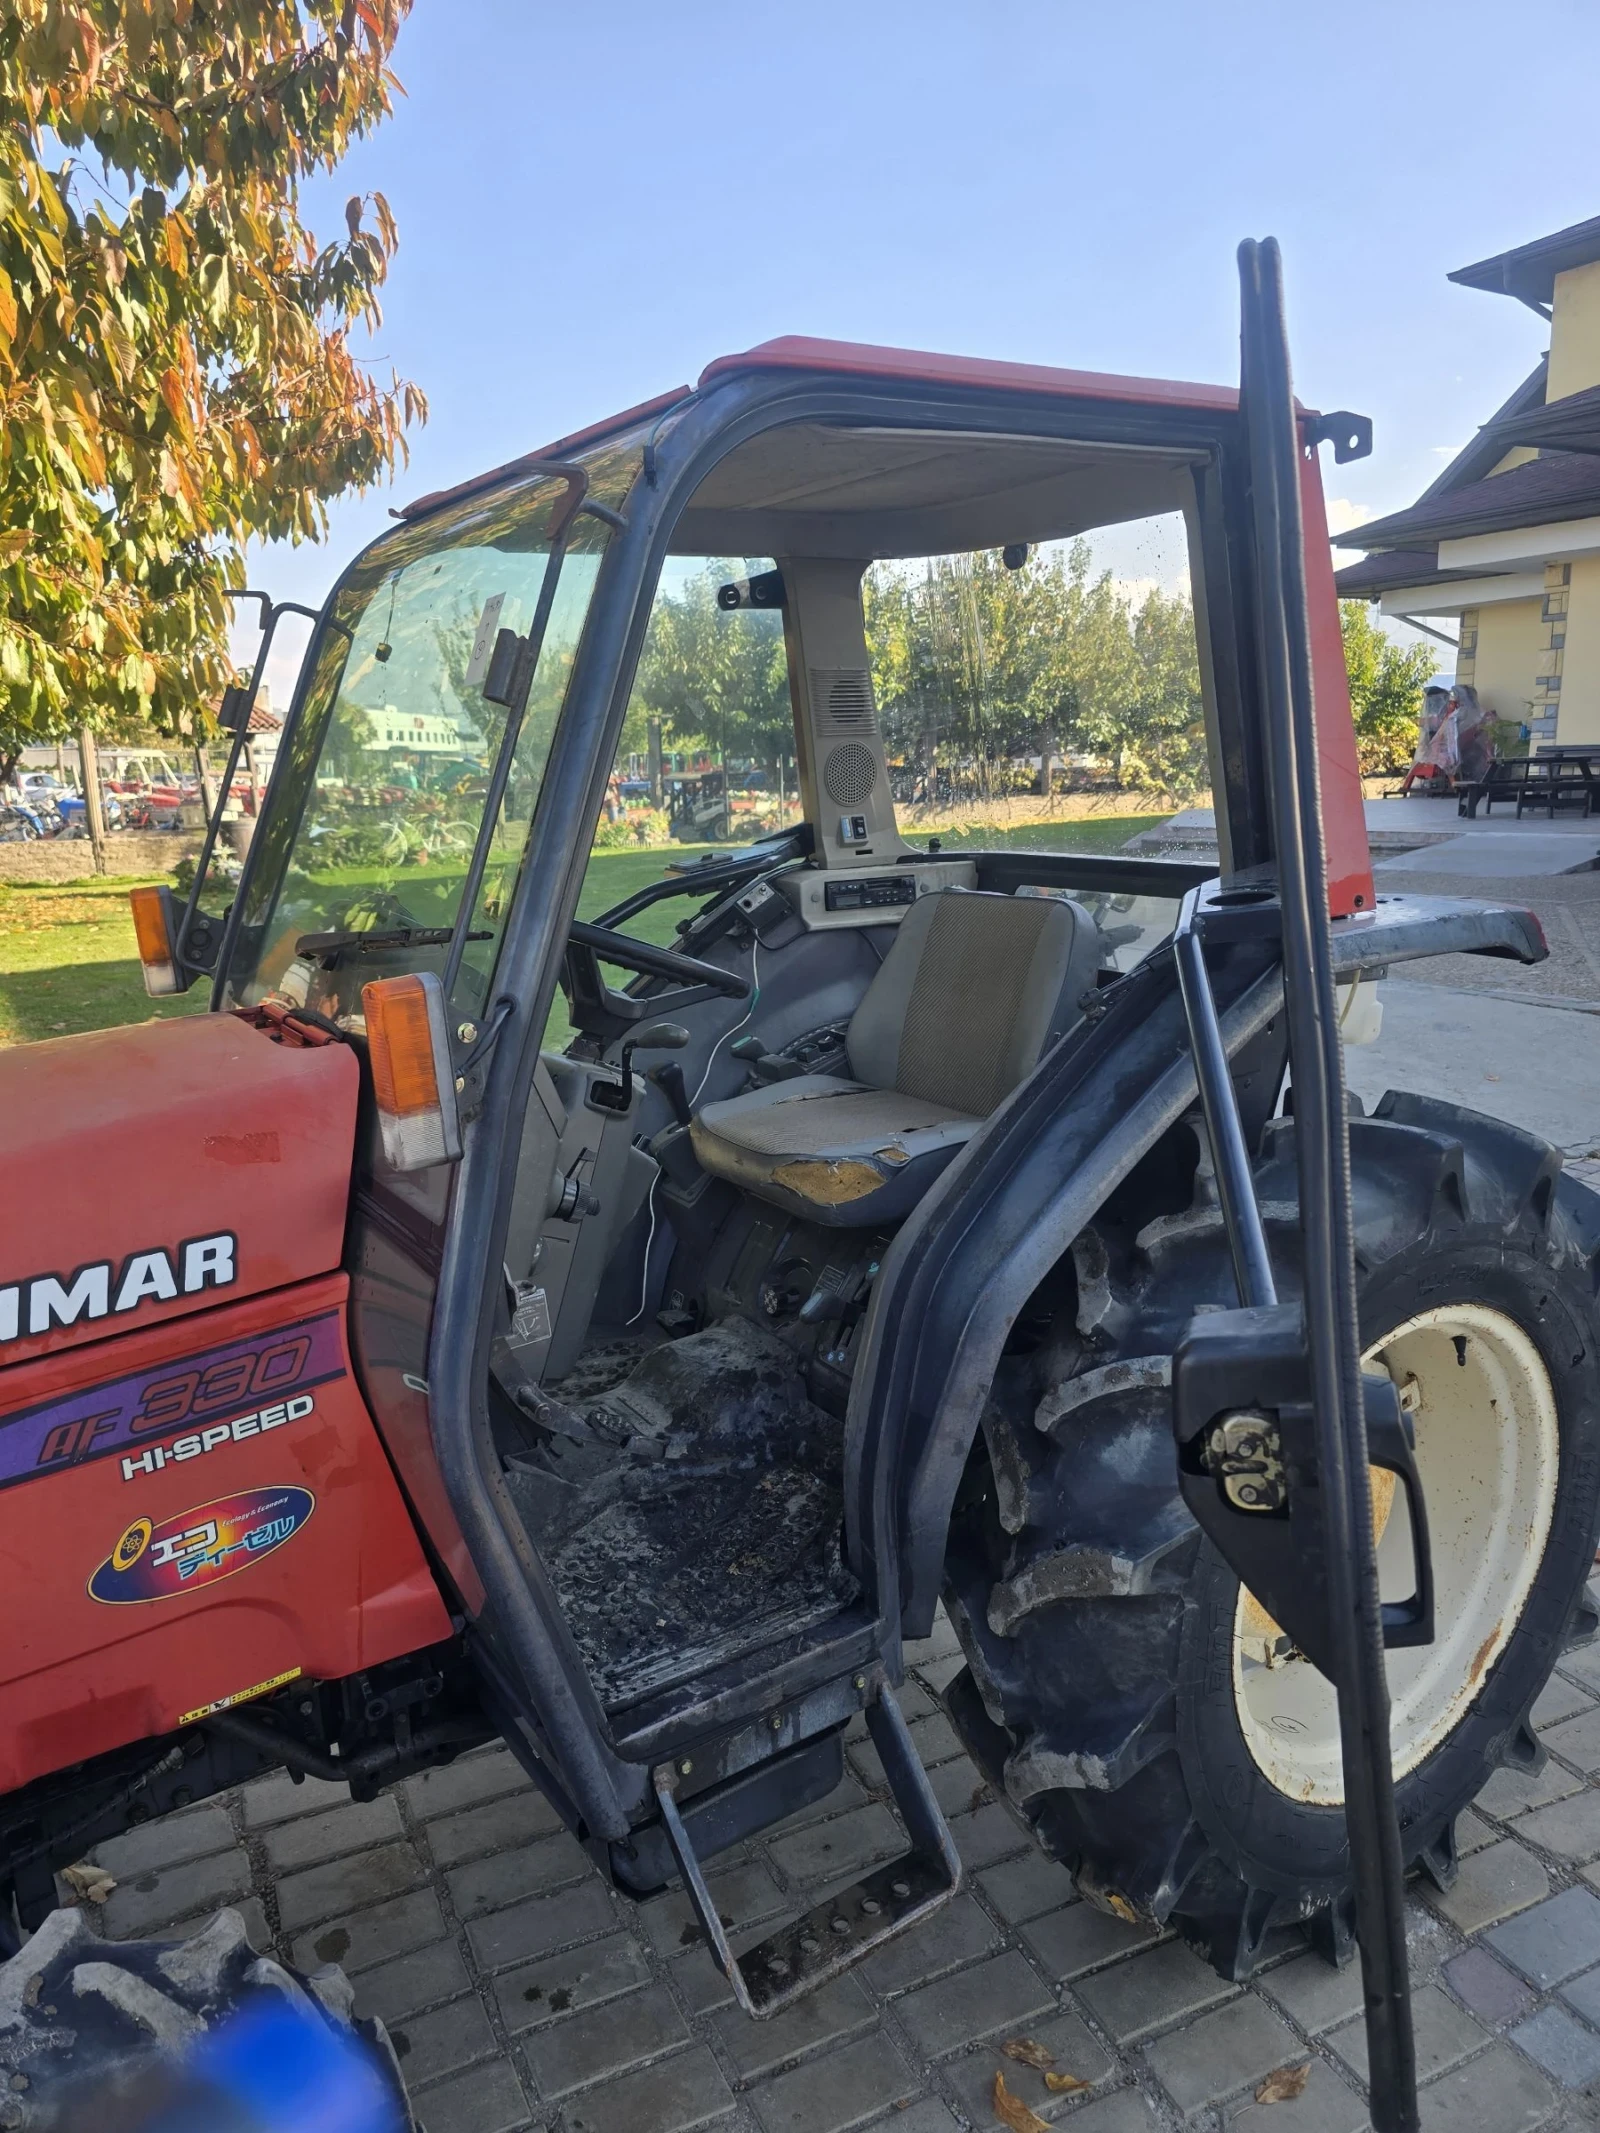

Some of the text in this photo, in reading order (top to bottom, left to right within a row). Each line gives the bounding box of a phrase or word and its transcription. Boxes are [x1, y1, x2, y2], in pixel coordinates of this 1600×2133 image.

[37, 1335, 312, 1466] AF 330
[120, 1394, 314, 1481] HI-SPEED
[151, 1519, 218, 1567] エコ
[222, 1511, 251, 1527] Ecology
[257, 1496, 289, 1513] Economy
[176, 1515, 295, 1580] ディーゼル
